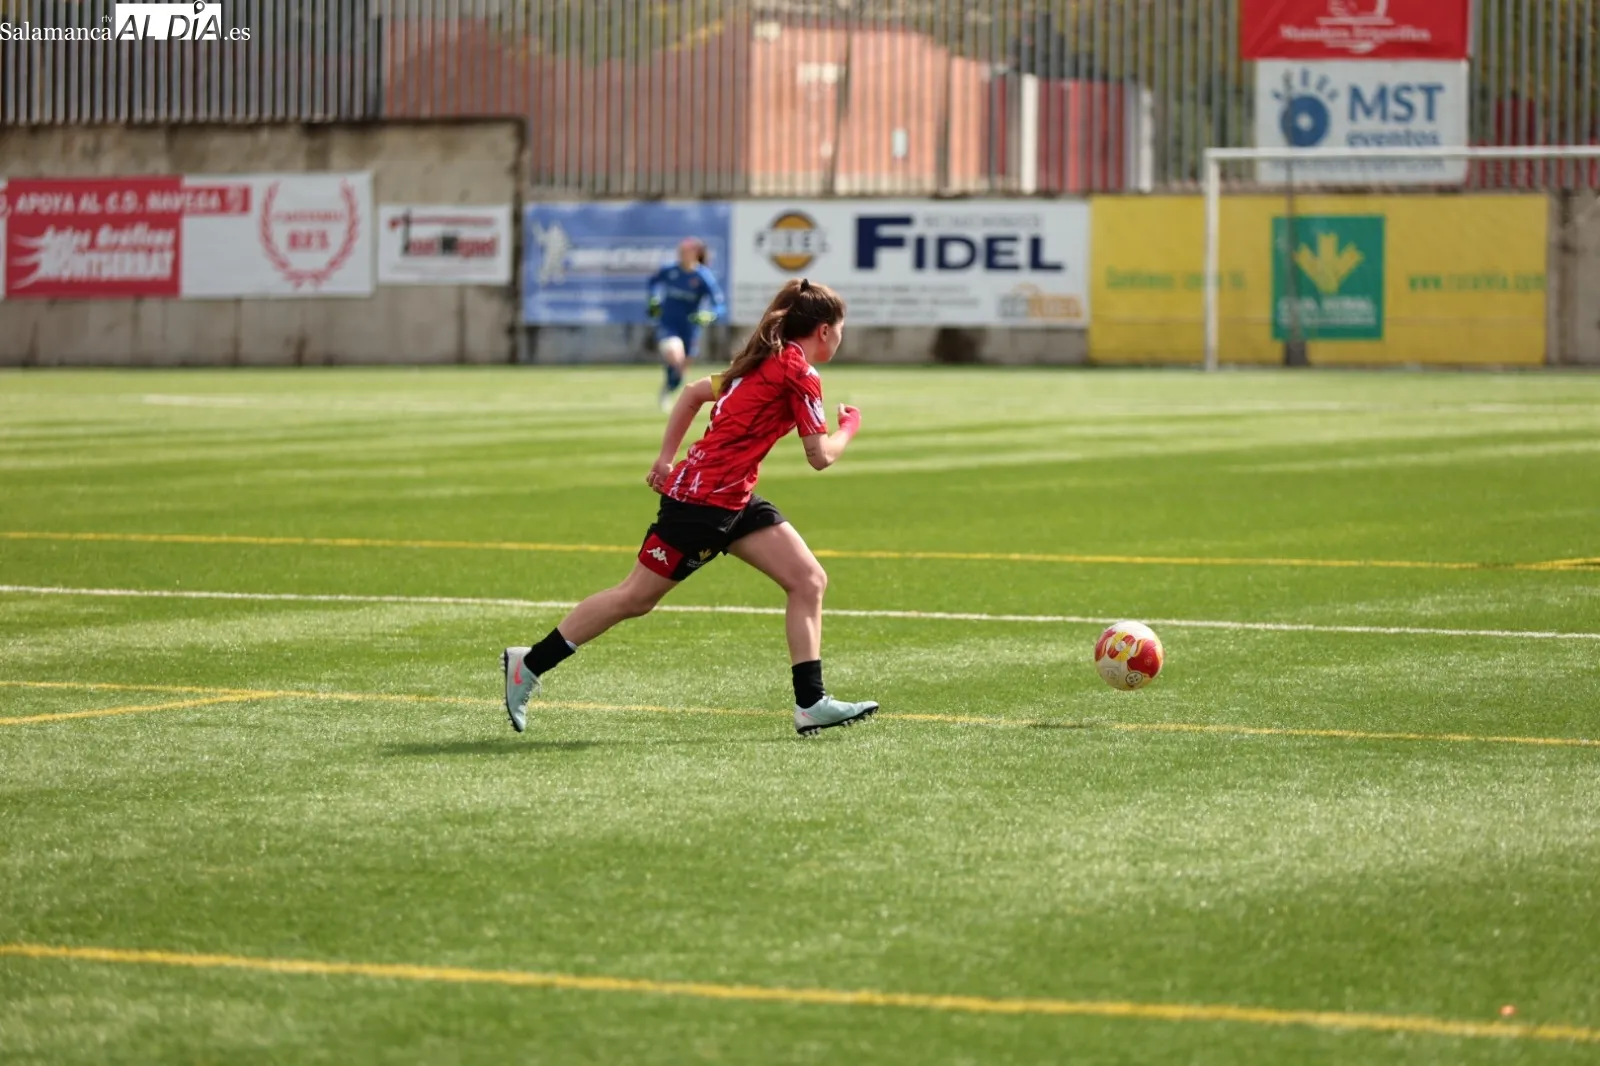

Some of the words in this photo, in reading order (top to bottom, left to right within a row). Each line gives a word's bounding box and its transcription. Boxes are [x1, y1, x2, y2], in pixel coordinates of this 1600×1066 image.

[1348, 82, 1444, 122] MST
[16, 192, 75, 214] APOYA
[78, 193, 100, 213] AL
[855, 215, 1065, 271] FIDEL
